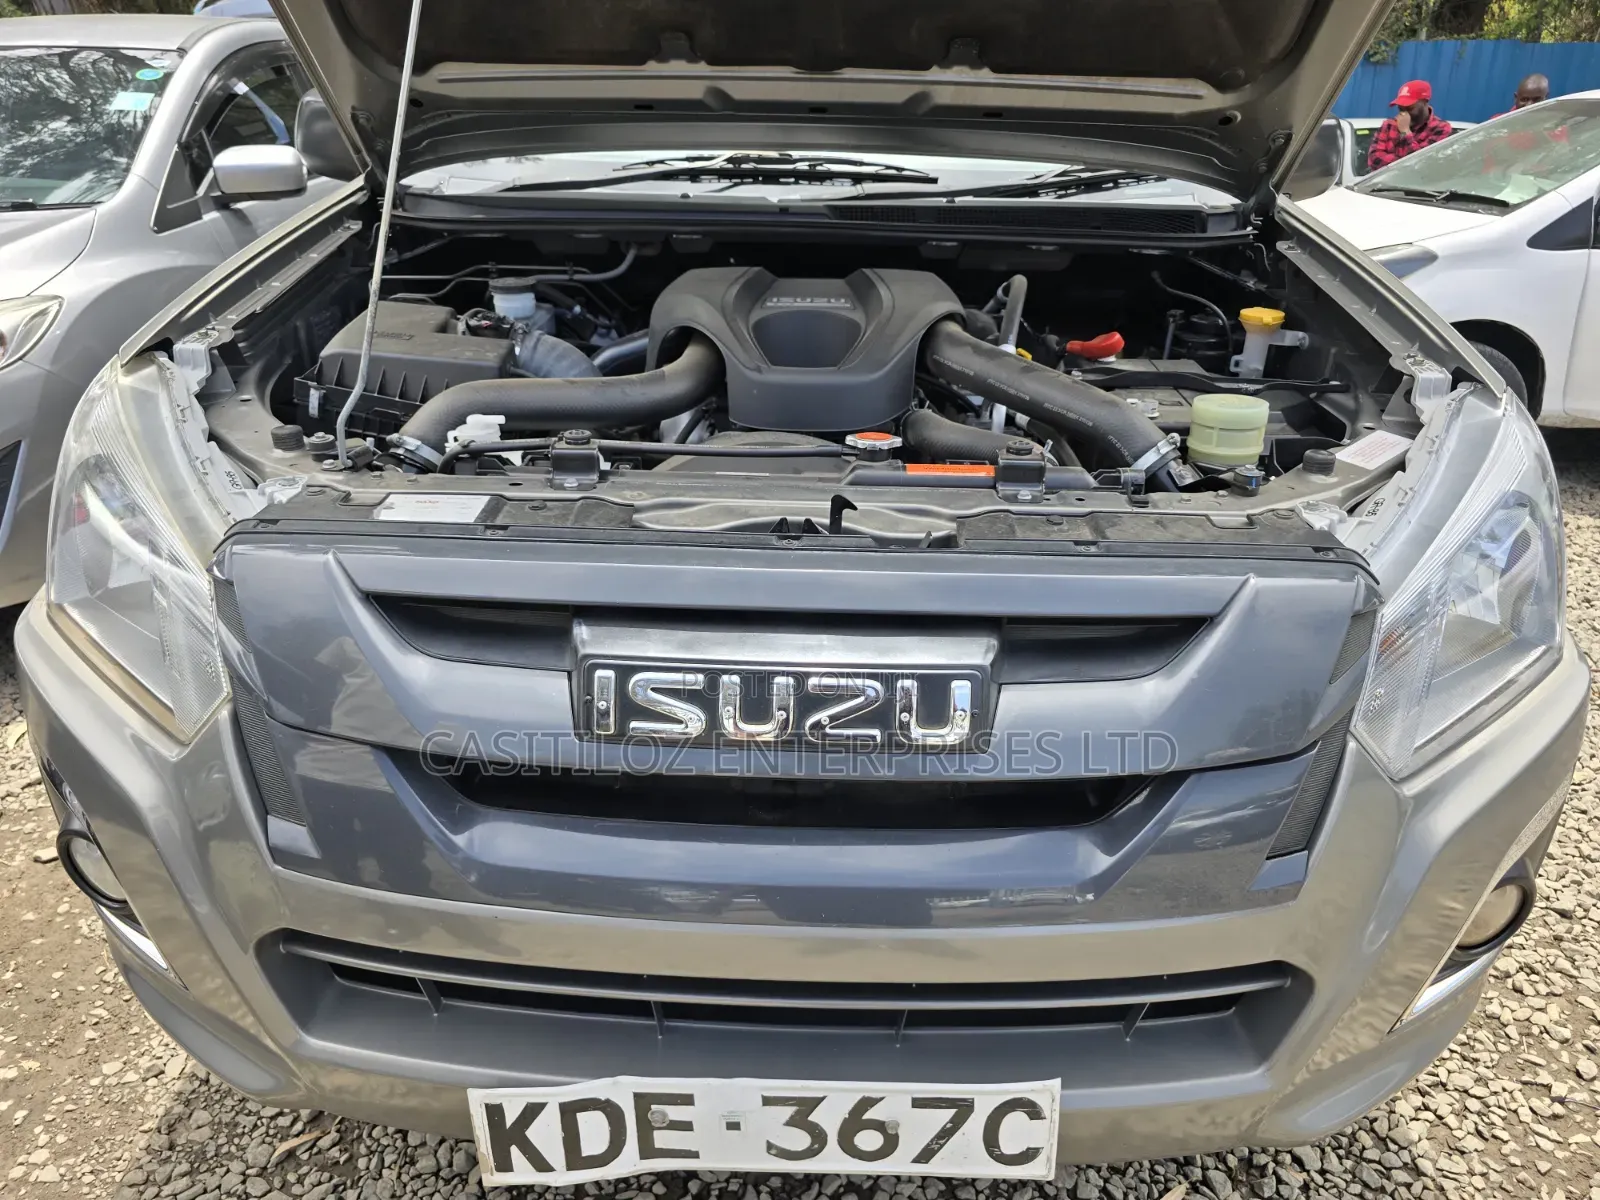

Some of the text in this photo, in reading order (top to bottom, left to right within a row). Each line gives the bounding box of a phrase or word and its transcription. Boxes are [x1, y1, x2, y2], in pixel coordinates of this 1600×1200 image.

[593, 668, 973, 746] ISUZU
[483, 1091, 1047, 1173] KDE 367C
